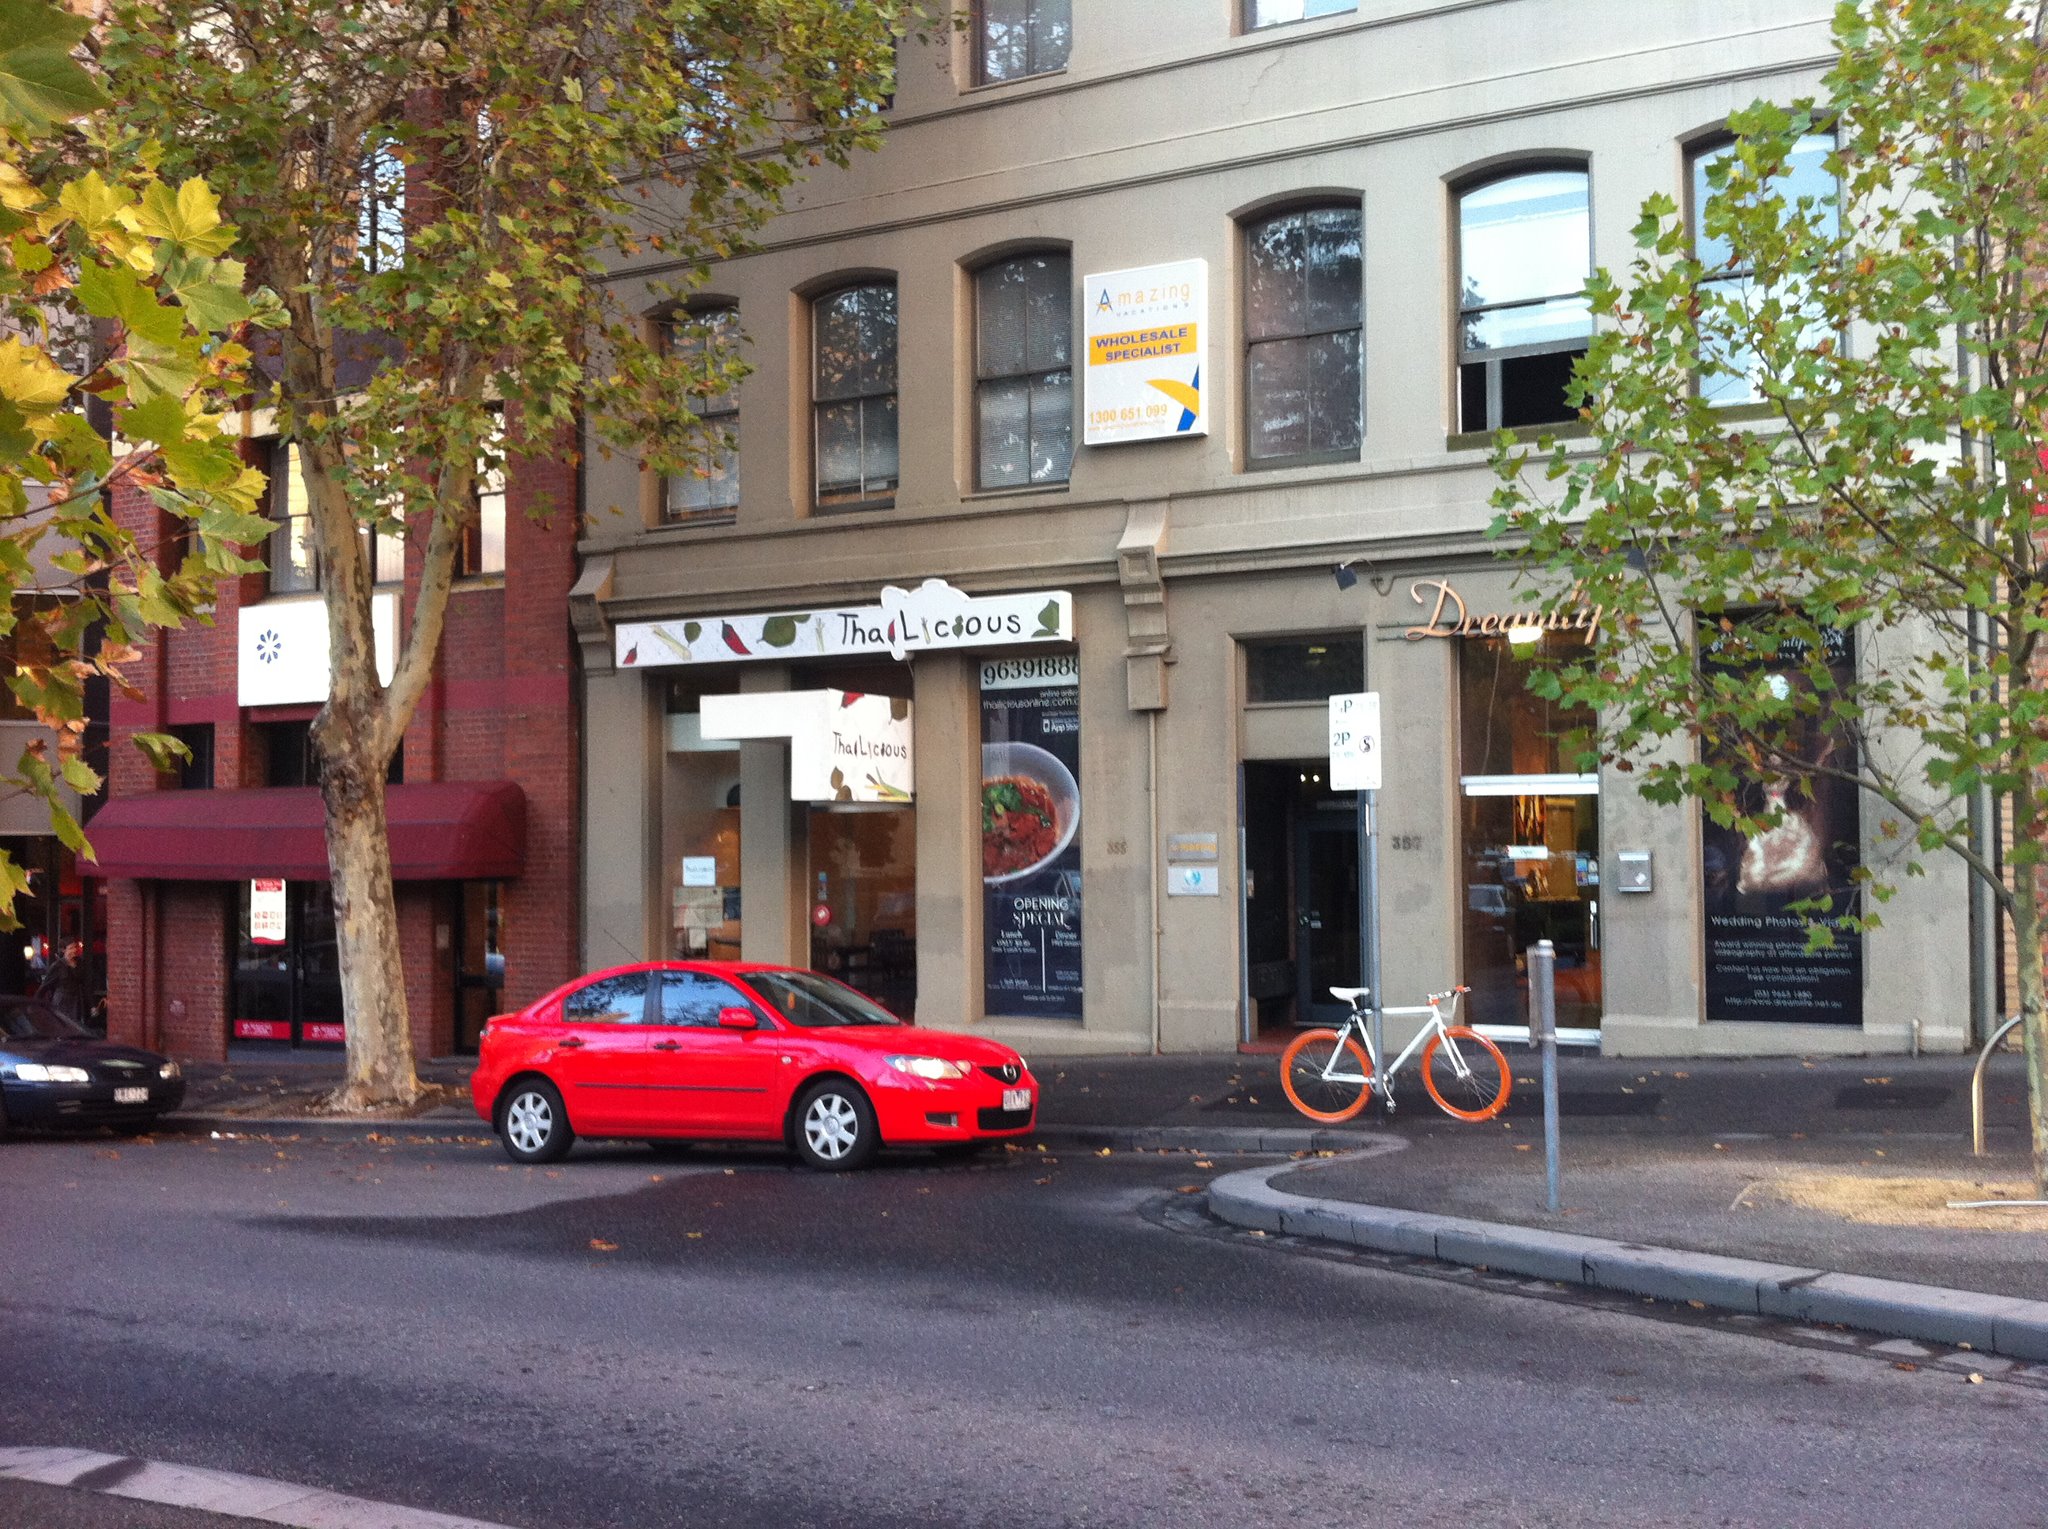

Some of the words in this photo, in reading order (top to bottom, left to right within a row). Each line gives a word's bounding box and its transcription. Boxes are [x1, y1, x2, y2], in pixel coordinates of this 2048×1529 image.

[1096, 284, 1190, 315] Amazing
[1096, 327, 1188, 349] WHOLESALE
[1105, 343, 1182, 362] SPECIALIST
[1089, 408, 1117, 424] 1300
[1121, 406, 1142, 421] 651
[1333, 731, 1351, 747] 2P
[1014, 897, 1069, 911] OPENING
[1012, 911, 1072, 930] SPECIAL
[1711, 915, 1762, 929] Wedding
[1714, 940, 1740, 949] Award
[1716, 964, 1750, 974] Contact
